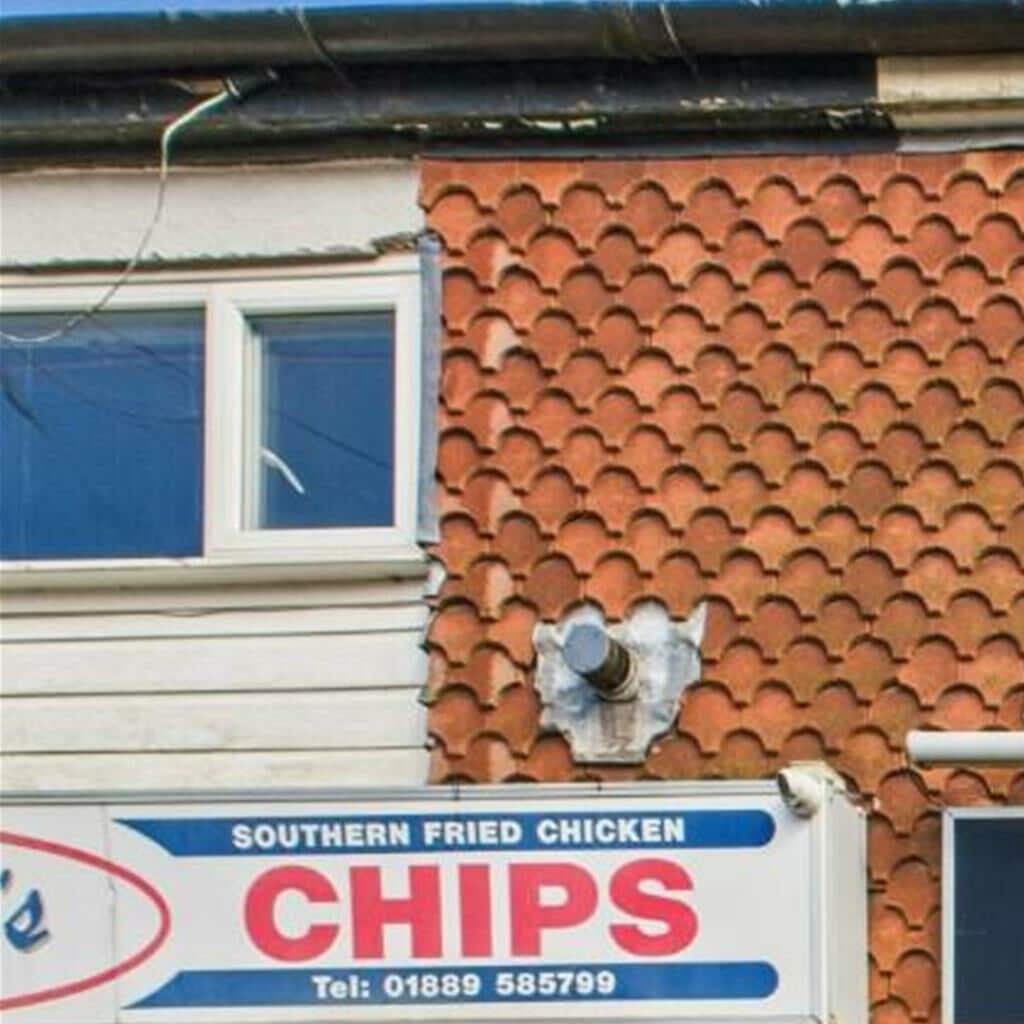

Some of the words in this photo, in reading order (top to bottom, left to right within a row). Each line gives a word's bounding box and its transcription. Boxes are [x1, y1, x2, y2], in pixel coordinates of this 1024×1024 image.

[232, 822, 411, 849] SOUTHERN
[423, 819, 523, 846] FRIED
[536, 817, 686, 844] CHICKEN
[243, 857, 700, 963] CHIPS
[313, 974, 371, 999] Tel:
[383, 973, 481, 998] 01889
[495, 970, 617, 996] 585799
